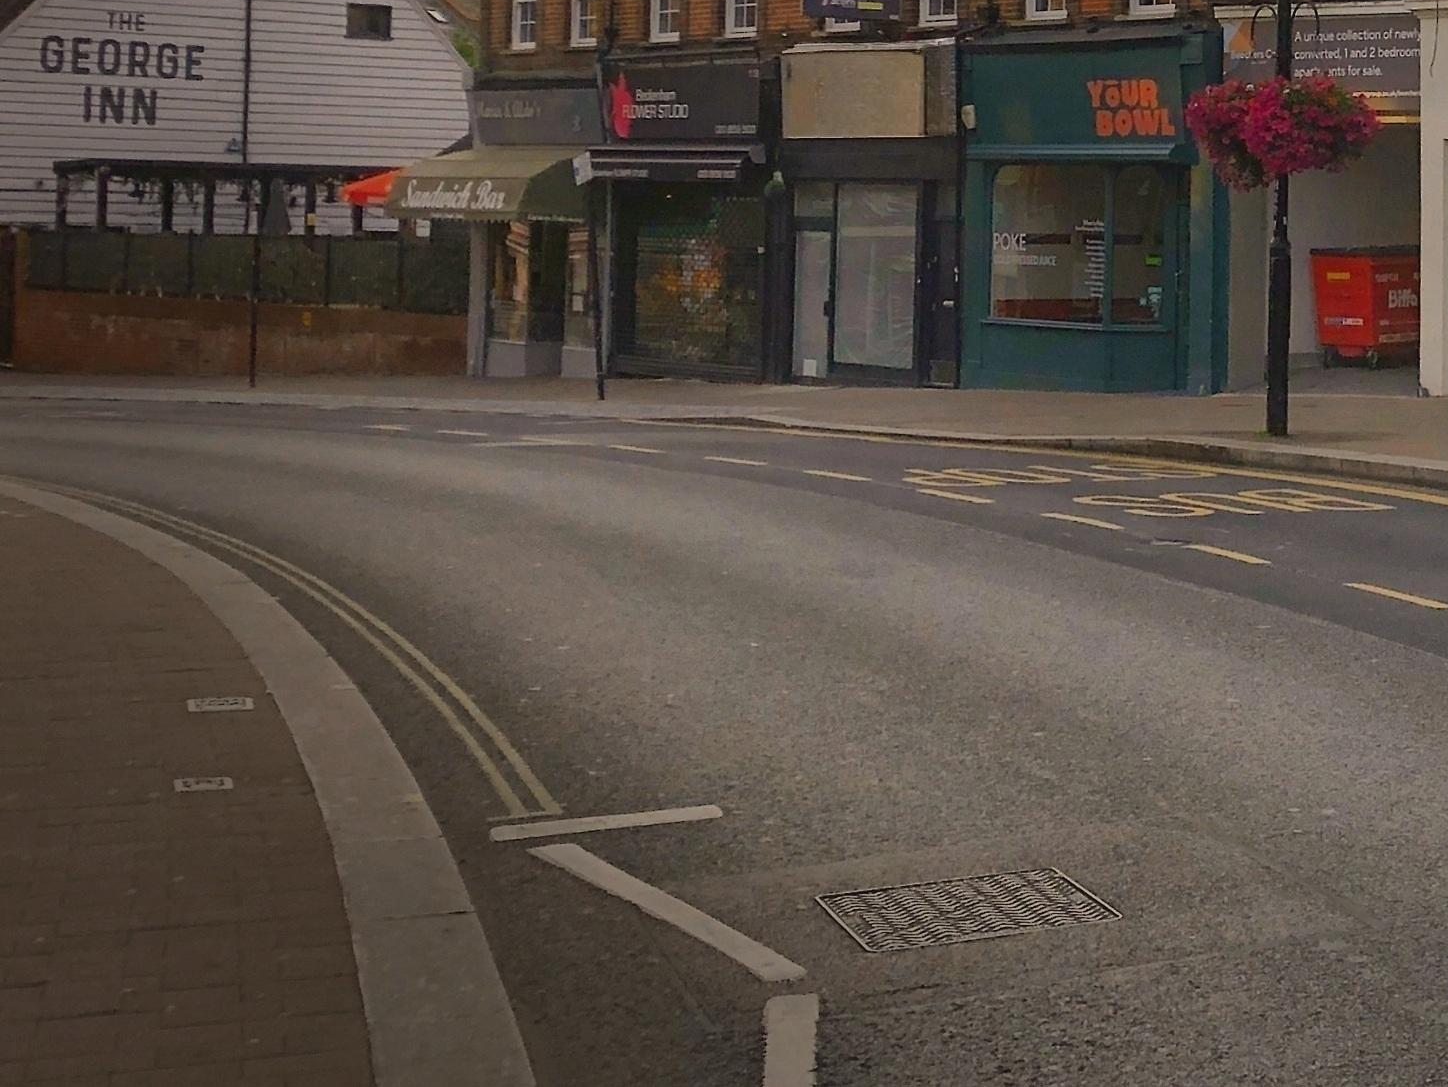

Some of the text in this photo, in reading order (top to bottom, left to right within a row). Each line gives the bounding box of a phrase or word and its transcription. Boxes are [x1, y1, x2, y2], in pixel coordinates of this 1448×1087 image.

[106, 11, 147, 32] THE
[1294, 31, 1302, 42] A
[1336, 29, 1381, 41] collection
[1383, 28, 1393, 40] of
[40, 35, 205, 81] GEORGE
[1351, 48, 1367, 59] and
[1369, 47, 1376, 58] 2
[1348, 66, 1361, 76] for
[82, 86, 158, 125] INN
[622, 104, 689, 119] FLOWER STUDIO
[1095, 108, 1176, 137] BOWL
[401, 178, 505, 210] Sandwich Bar
[992, 232, 1027, 252] POKE
[1388, 288, 1419, 309] Biffa
